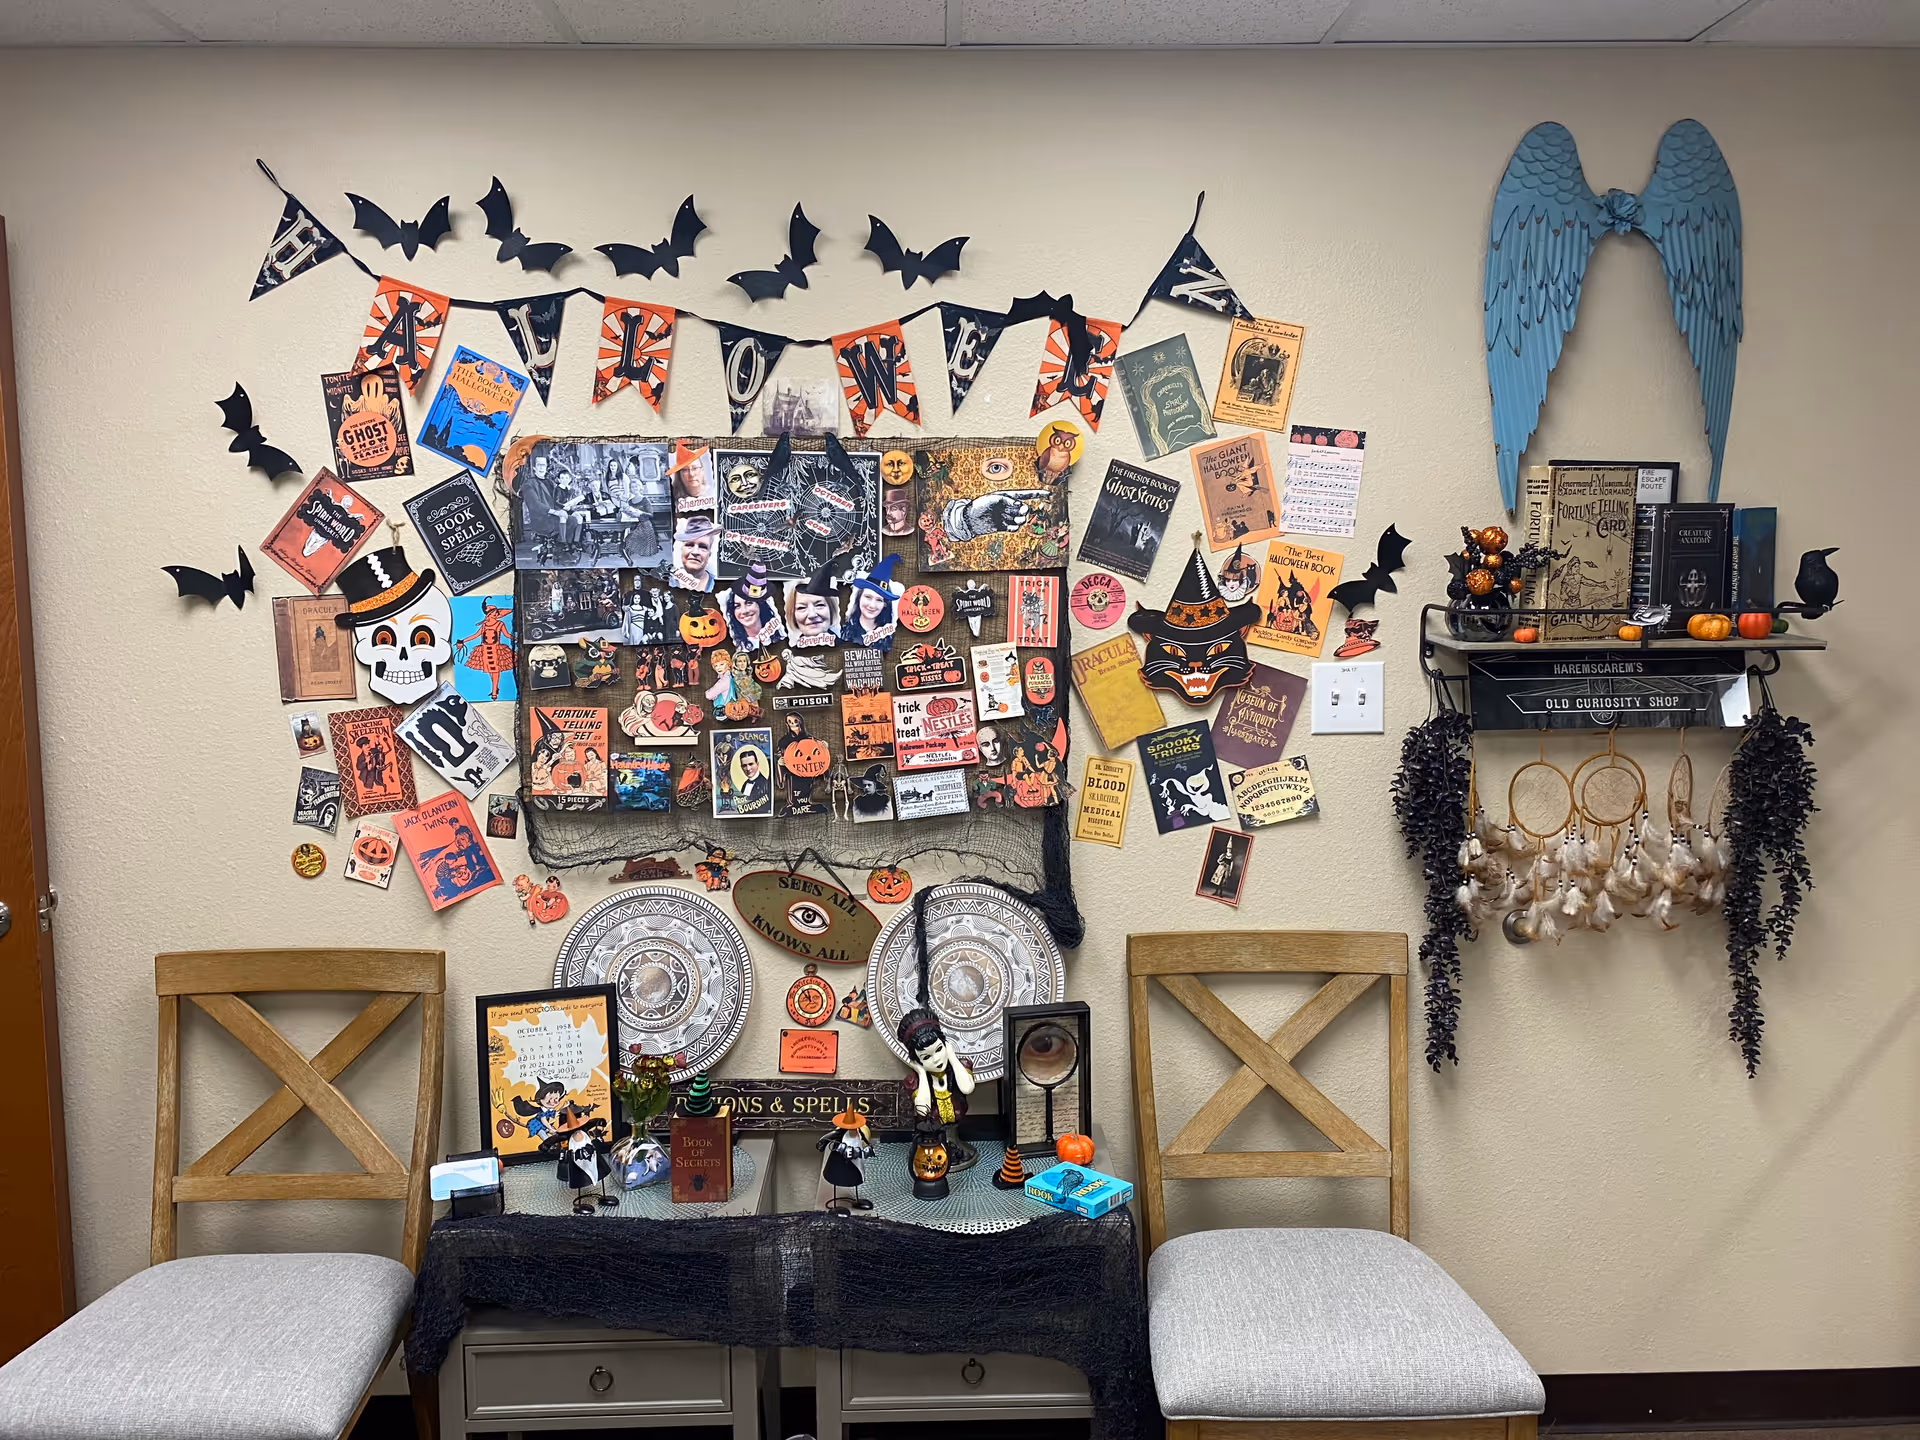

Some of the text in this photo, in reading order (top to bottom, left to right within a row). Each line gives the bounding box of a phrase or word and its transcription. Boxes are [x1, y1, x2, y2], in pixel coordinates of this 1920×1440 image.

[1235, 321, 1299, 339] Forbidden Knowledge
[452, 373, 514, 407] HALLOWEEN
[456, 365, 516, 399] THE BOOK OF
[1156, 382, 1184, 398] CHRONICLES
[343, 420, 388, 446] GHOST
[397, 433, 407, 442] SEE
[350, 435, 388, 452] SHOW
[353, 445, 390, 460] SEANCE
[1202, 443, 1248, 465] The GIANT
[1203, 452, 1251, 474] HALLOWEEN
[1110, 465, 1178, 494] THE FIRESIDE BOOK OF
[1214, 464, 1243, 480] BOOK
[814, 486, 853, 510] OCTOBER
[1105, 477, 1171, 513] Ghost Stories
[1557, 488, 1587, 497] MADAME
[1588, 488, 1598, 496] LE
[678, 496, 715, 510] Shannon
[730, 501, 787, 512] CAREGIVERS
[331, 509, 342, 519] THE
[1557, 499, 1630, 527] FORTUNE TELLING
[306, 500, 355, 543] SPIRIT WORLD
[313, 516, 341, 539] UNMASKED
[434, 507, 478, 536] BOOK
[1529, 501, 1542, 549] FORTUN
[1596, 517, 1627, 539] CARD
[440, 522, 486, 551] SPELLS
[725, 532, 790, 549] OF THE MONTH
[1678, 529, 1713, 539] CREATURE
[1679, 536, 1712, 545] ANATOMY
[1284, 546, 1325, 562] The Best
[1269, 554, 1336, 576] HALLOWEEN BOOK
[673, 569, 700, 588] Laurie
[1081, 576, 1112, 590] DECCA
[302, 606, 339, 615] DRACULA
[955, 595, 992, 612] SPIRIT WORLD
[1550, 613, 1583, 627] GAME
[758, 618, 782, 643] Cristin
[863, 625, 895, 645] Zabrina
[799, 634, 836, 647] Beverley
[1018, 636, 1049, 644] TREAT
[844, 649, 881, 661] BEWARE!
[904, 664, 927, 674] TRICK
[931, 660, 955, 670] TREAT
[1072, 640, 1137, 687] DRACULA
[1098, 664, 1117, 675] Bram
[1553, 661, 1644, 676] HAREMSCAREM'S
[920, 674, 943, 682] KISSES
[792, 696, 829, 707] POISON
[898, 701, 921, 714] trick
[1236, 688, 1279, 713] MUSEUM OF
[1545, 695, 1680, 710] OLD CURIOSITY SHOP
[552, 709, 598, 719] FORTUNE
[903, 716, 913, 725] or
[1237, 705, 1279, 729] ANTIQUITY
[352, 720, 383, 730] DANCING
[562, 721, 603, 730] TELLING
[896, 726, 920, 739] treat
[348, 725, 392, 745] SKELETON
[573, 731, 594, 741] SET
[1227, 724, 1269, 747] ILLUSTRATED
[1147, 734, 1203, 753] SPOOKY
[1151, 742, 1201, 760] TRICKS
[1258, 766, 1279, 776] OUIJA
[1087, 777, 1126, 792] BLOOD
[1236, 775, 1308, 801] ABCDEFGHIJKLM
[557, 796, 566, 804] 15
[737, 795, 770, 814] BOURDINI
[935, 793, 964, 801] COFFINS
[1239, 783, 1310, 811] NOPQRSTUVWXYZ
[1251, 794, 1302, 812] 1234567890
[402, 799, 459, 829] JACK O'LANTERN
[792, 806, 812, 815] DARE
[1083, 805, 1121, 818] MEDICAL
[422, 817, 449, 833] TWINS
[633, 872, 670, 880] CIGARS
[778, 876, 859, 918] SEES ALL
[751, 913, 850, 962] KNOWS ALL
[525, 1006, 556, 1014] NORCROSS
[579, 1002, 604, 1010] everyone
[517, 1027, 548, 1035] OCTOBER
[770, 1097, 786, 1113] &
[792, 1096, 870, 1113] SPELLS
[682, 1136, 713, 1148] BOOK
[691, 1148, 705, 1156] OF
[675, 1156, 721, 1169] SECRETS
[1027, 1185, 1054, 1202] ROOK
[1073, 1178, 1107, 1197] ROOK
